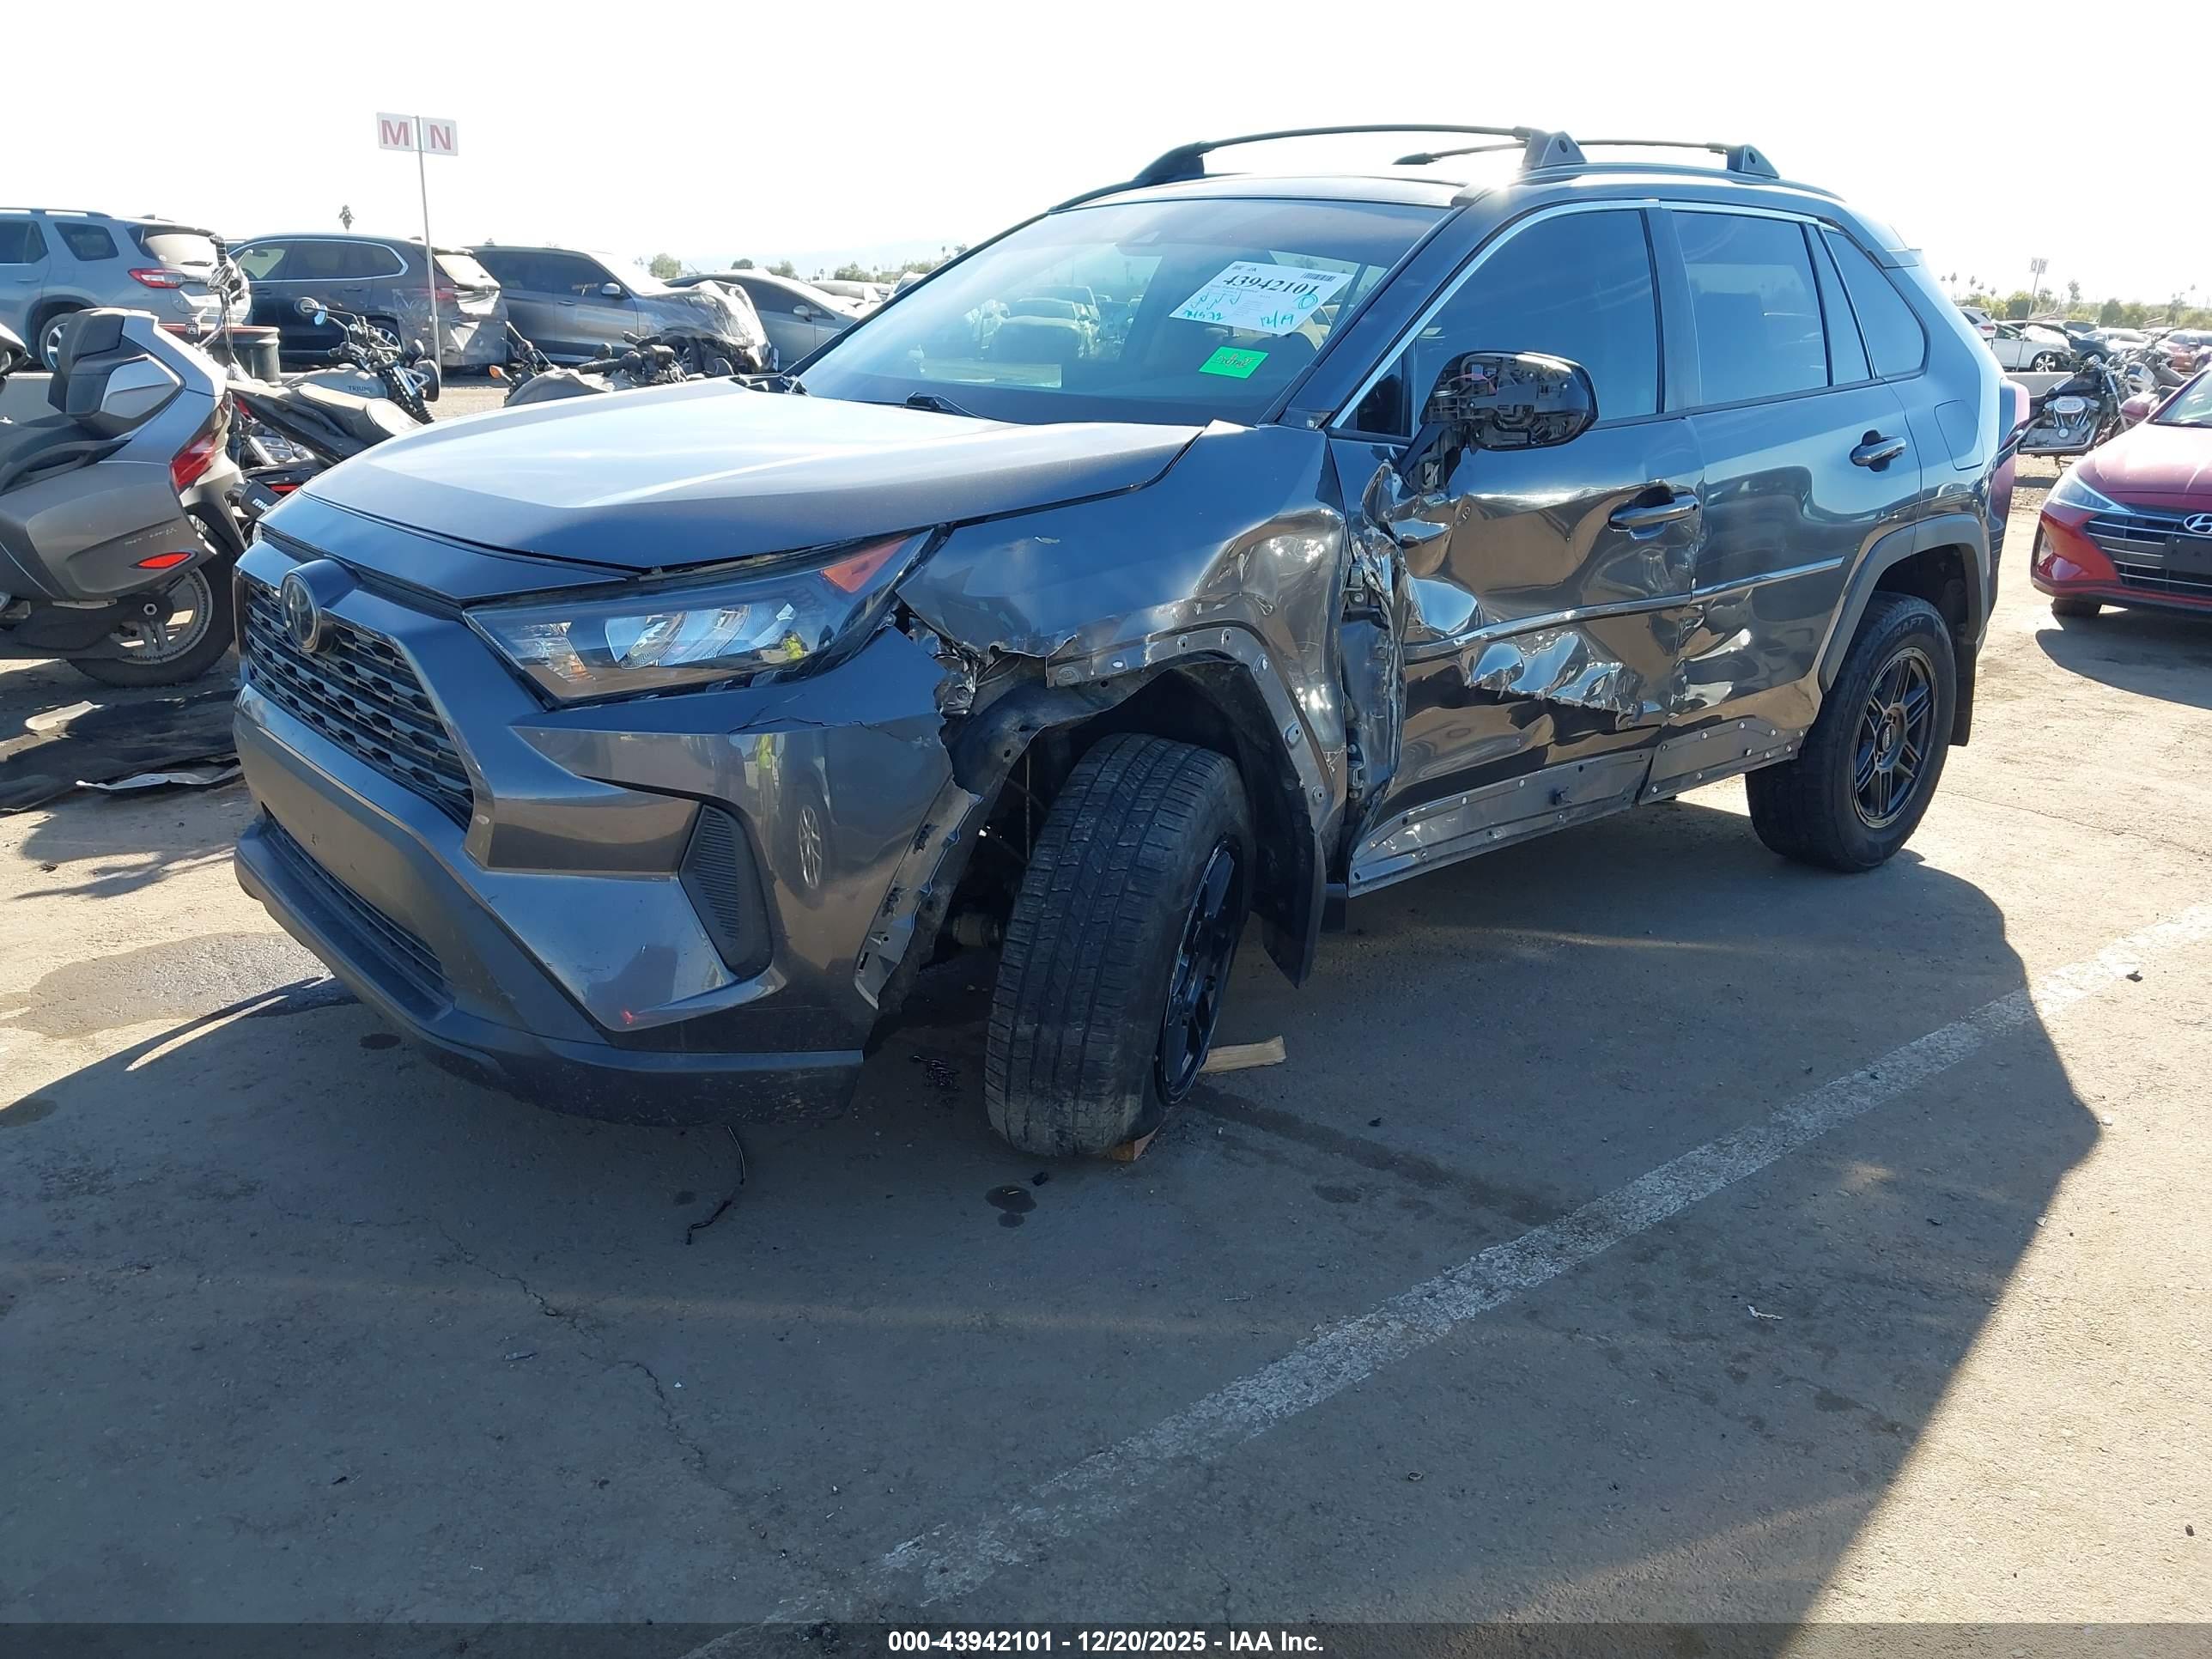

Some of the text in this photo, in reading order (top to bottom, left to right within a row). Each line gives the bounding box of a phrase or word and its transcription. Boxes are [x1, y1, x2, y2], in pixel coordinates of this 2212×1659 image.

[381, 119, 410, 146] M
[430, 125, 451, 150] N
[1222, 275, 1320, 295] 43942101
